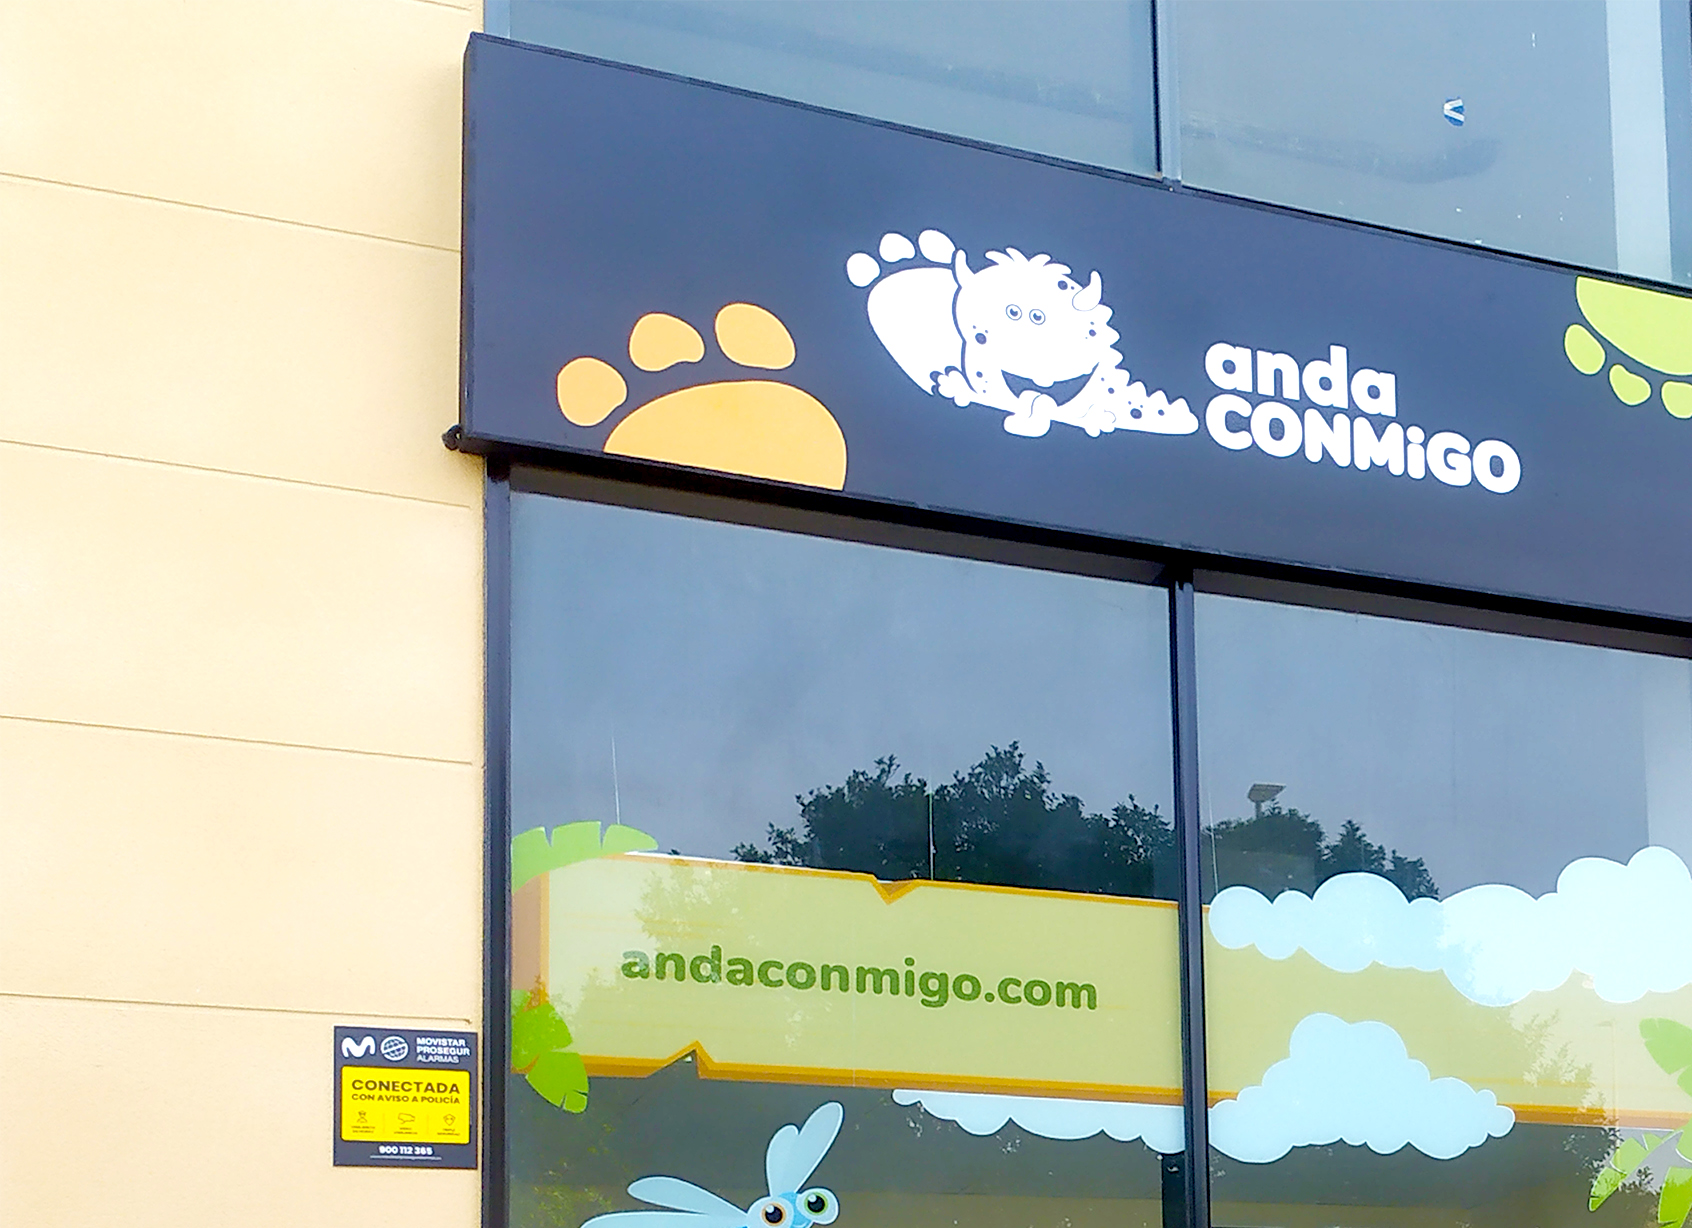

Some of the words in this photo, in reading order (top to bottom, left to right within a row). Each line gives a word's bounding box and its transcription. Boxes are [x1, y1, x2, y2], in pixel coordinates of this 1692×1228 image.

[1204, 342, 1397, 417] anda
[620, 945, 1098, 1010] andaconmigo.com
[416, 1037, 466, 1047] MOVISTAR
[416, 1046, 471, 1056] PROSEGUR
[416, 1054, 460, 1064] ALARMAS
[351, 1079, 461, 1095] CONECTADA
[351, 1093, 375, 1101] CON
[377, 1094, 409, 1103] AVISO
[411, 1095, 419, 1103] A
[379, 1145, 398, 1155] 900
[399, 1146, 414, 1155] 112
